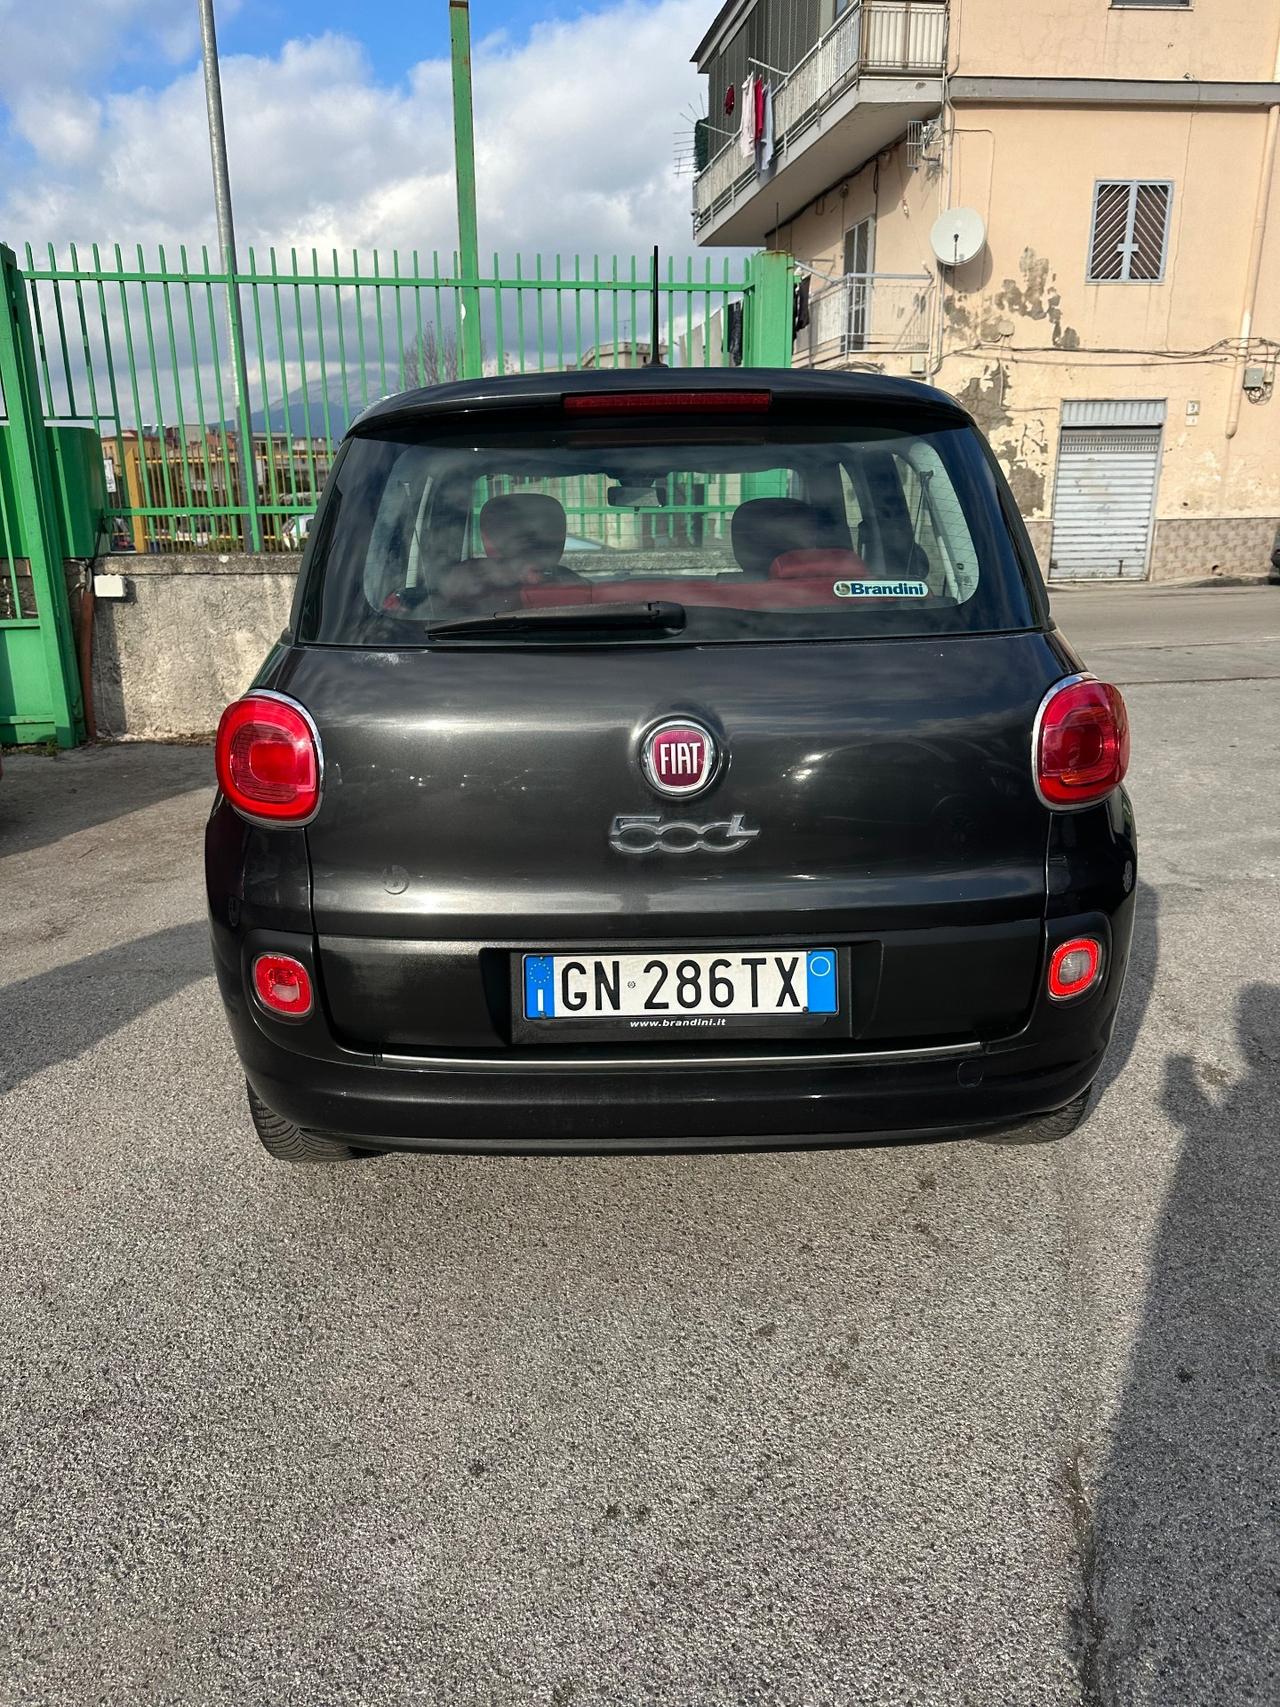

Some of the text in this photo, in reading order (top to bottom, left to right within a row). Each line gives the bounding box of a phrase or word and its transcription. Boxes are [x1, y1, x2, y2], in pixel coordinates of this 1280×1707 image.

[851, 583, 924, 595] Brandini
[660, 742, 701, 775] FIAT
[609, 814, 760, 854] 500L
[561, 960, 621, 1011] GN
[643, 956, 801, 1010] 286TX
[630, 1018, 726, 1028] www.brandini.it
